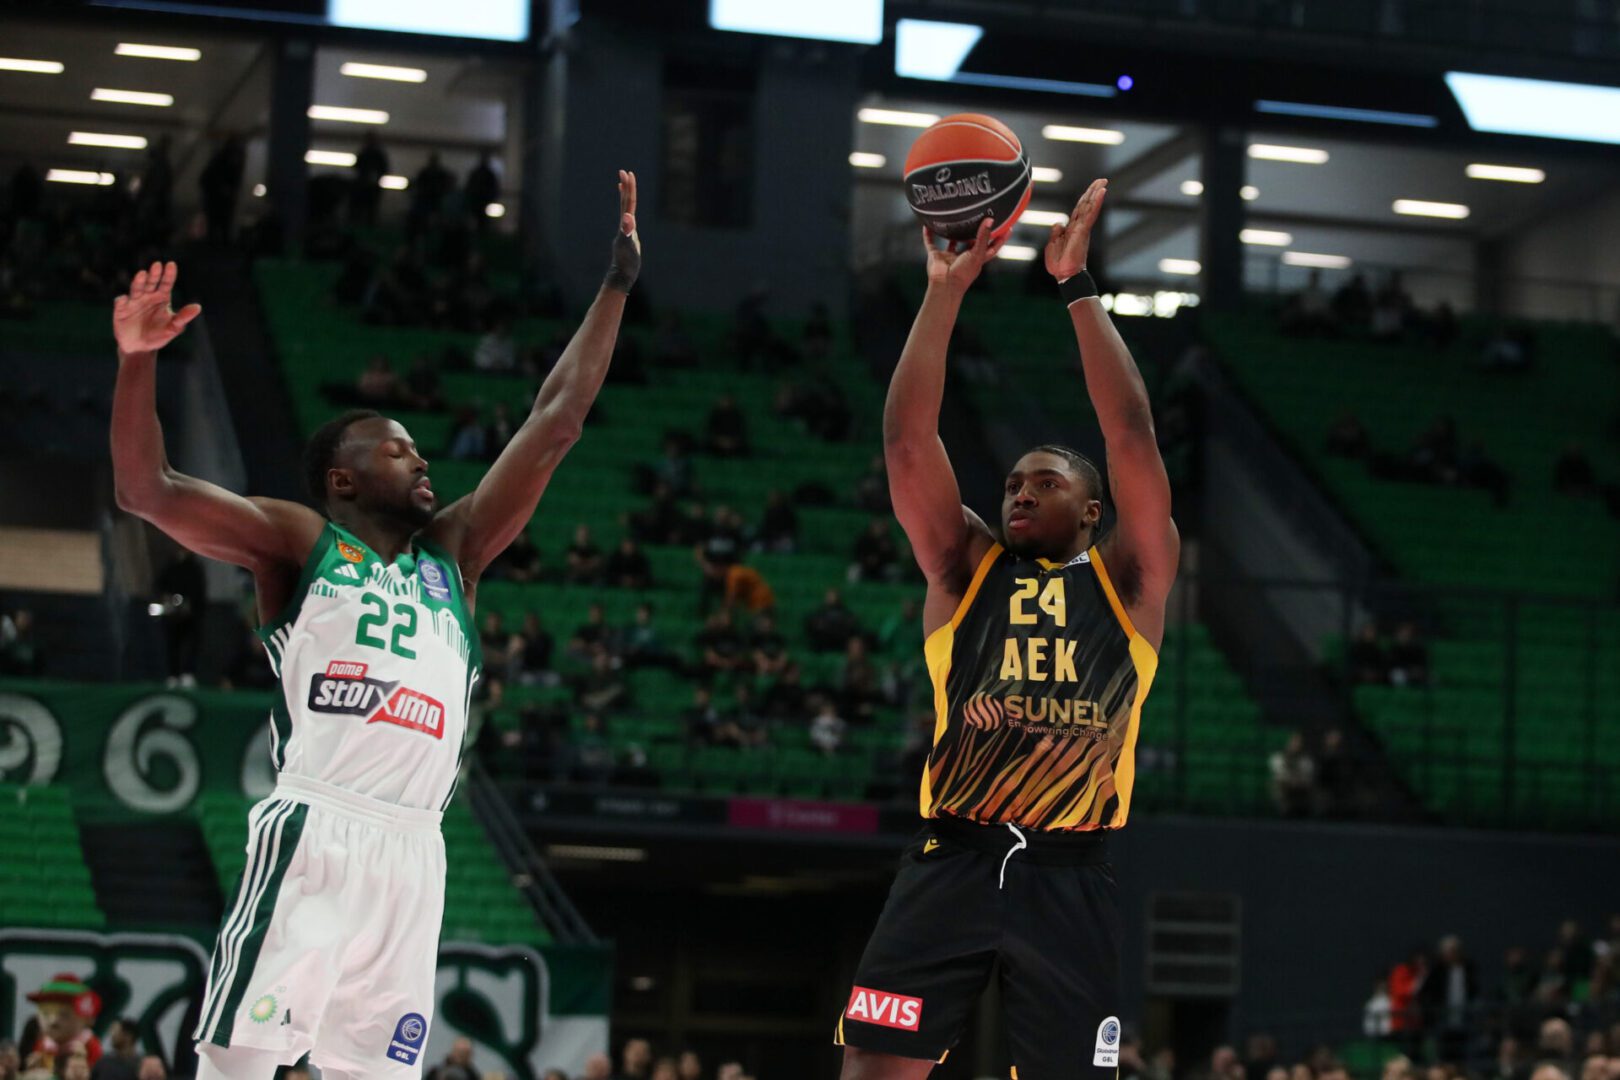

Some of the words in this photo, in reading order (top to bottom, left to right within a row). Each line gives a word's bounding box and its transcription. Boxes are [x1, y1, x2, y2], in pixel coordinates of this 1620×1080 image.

[912, 172, 992, 204] SPALDING
[1010, 577, 1066, 627] 24
[355, 591, 418, 660] 22
[328, 662, 364, 677] pame
[1000, 637, 1078, 682] AEK
[1003, 694, 1108, 729] SUNEL
[1007, 719, 1070, 738] Emowering
[848, 990, 920, 1027] AVIS
